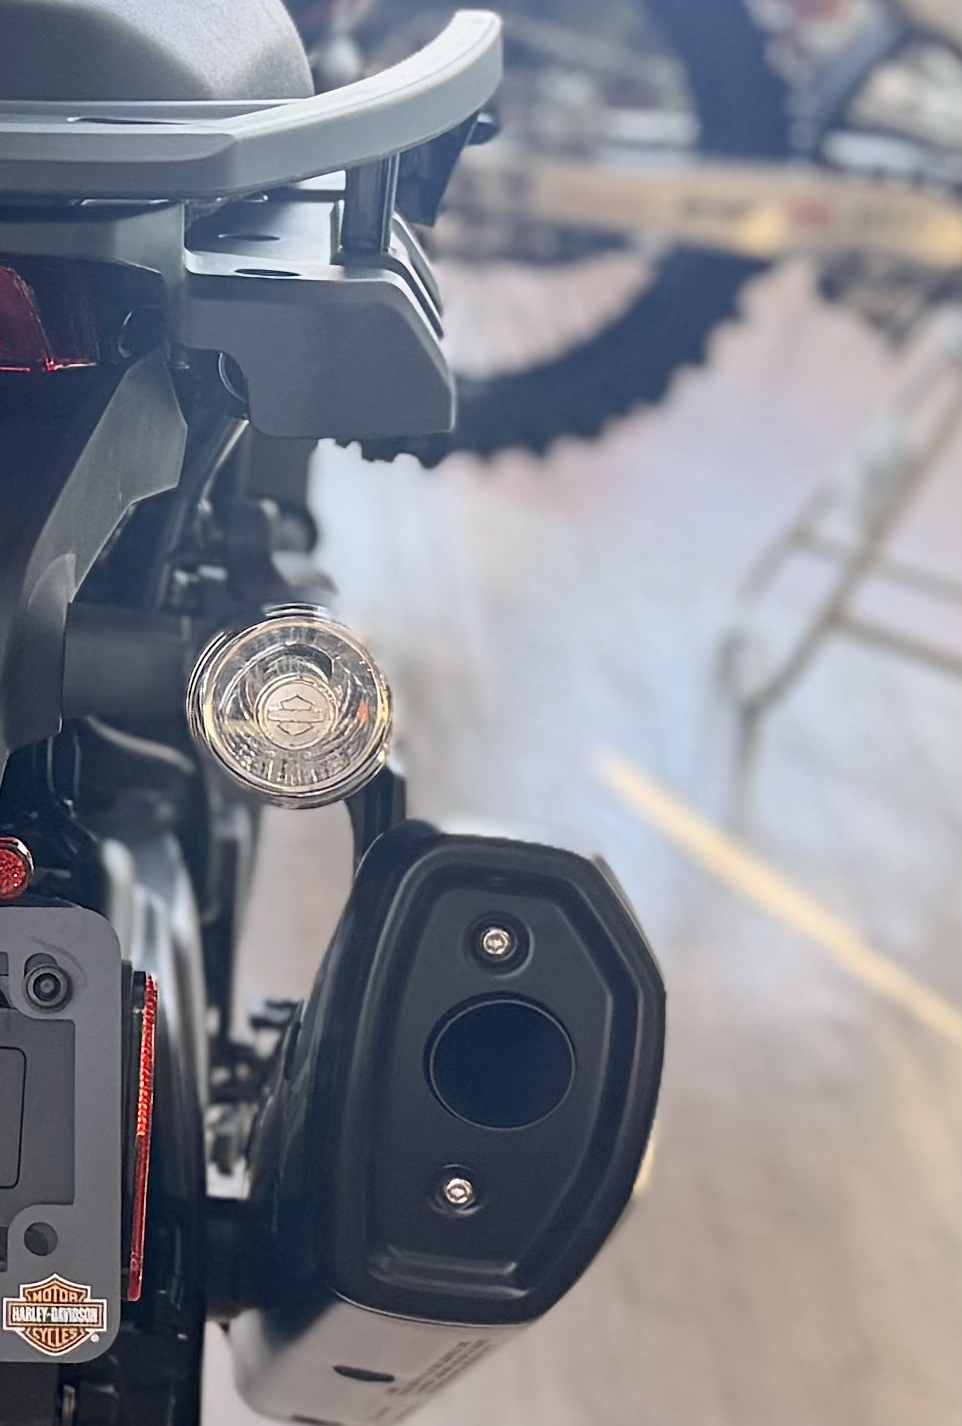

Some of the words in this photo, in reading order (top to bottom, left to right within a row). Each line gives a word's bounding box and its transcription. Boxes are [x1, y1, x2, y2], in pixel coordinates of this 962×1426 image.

[32, 1285, 79, 1303] MOTOR
[12, 1306, 98, 1323] HARLEY-DAVIDSON
[32, 1327, 78, 1347] CYCLES
